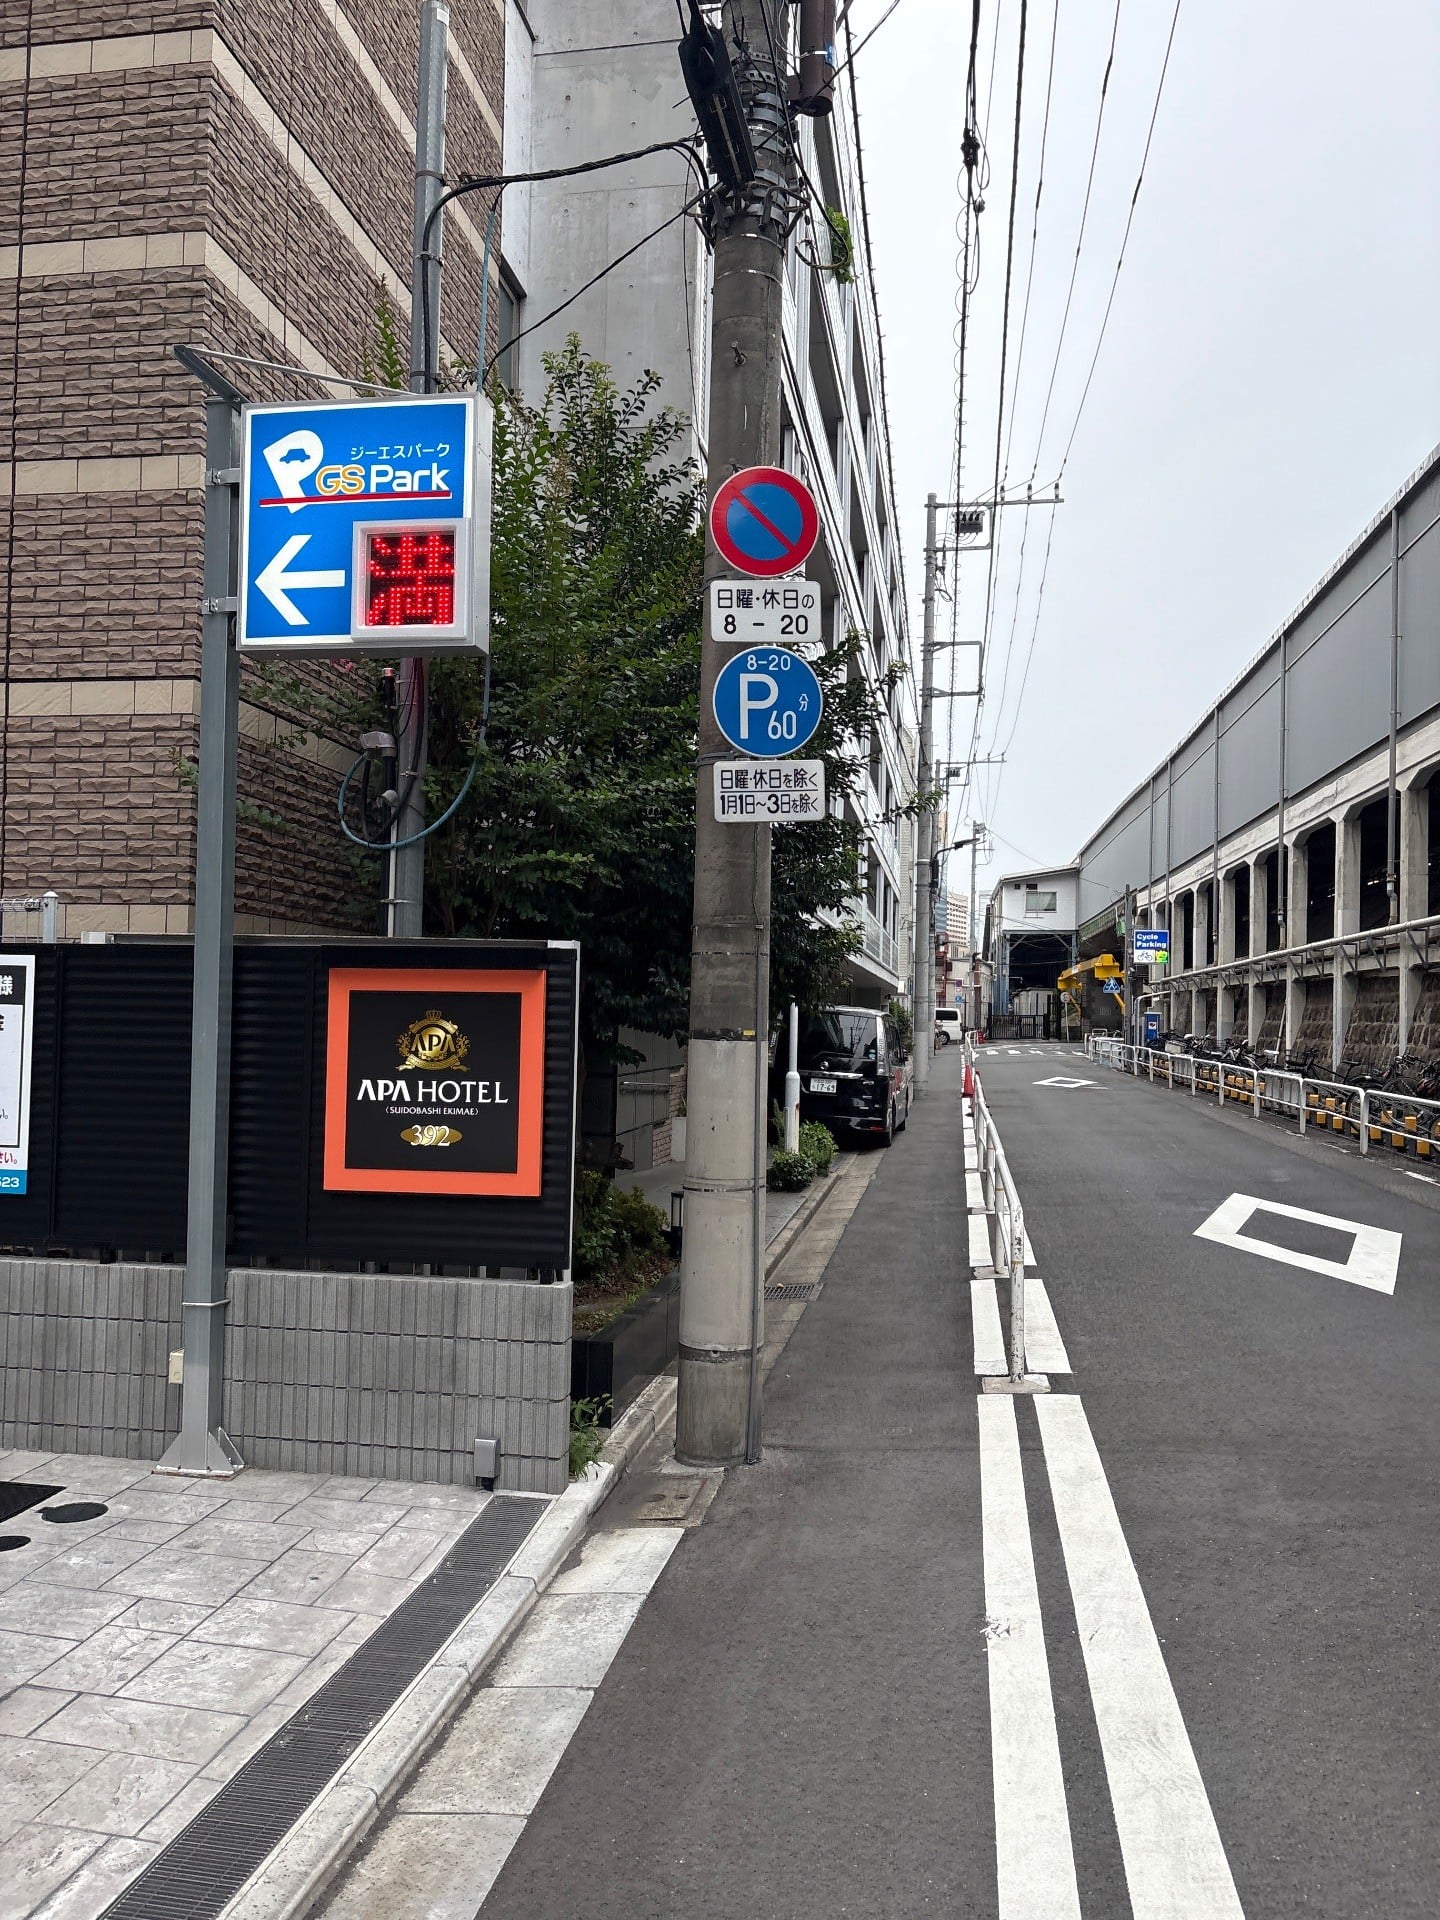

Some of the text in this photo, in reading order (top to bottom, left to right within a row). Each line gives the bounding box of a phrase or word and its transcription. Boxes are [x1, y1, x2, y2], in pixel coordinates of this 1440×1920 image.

[351, 442, 450, 461] ジーエスパーク
[368, 534, 455, 626] 満
[717, 588, 815, 609] 日曜・休日の
[746, 654, 791, 671] 8-20
[739, 673, 779, 740] P
[721, 768, 818, 789] 日曜・休日を除く
[1136, 933, 1159, 941] Cycle
[1136, 941, 1167, 949] Parking
[356, 1079, 509, 1104] APA HOTEL
[410, 1124, 451, 1147] 392
